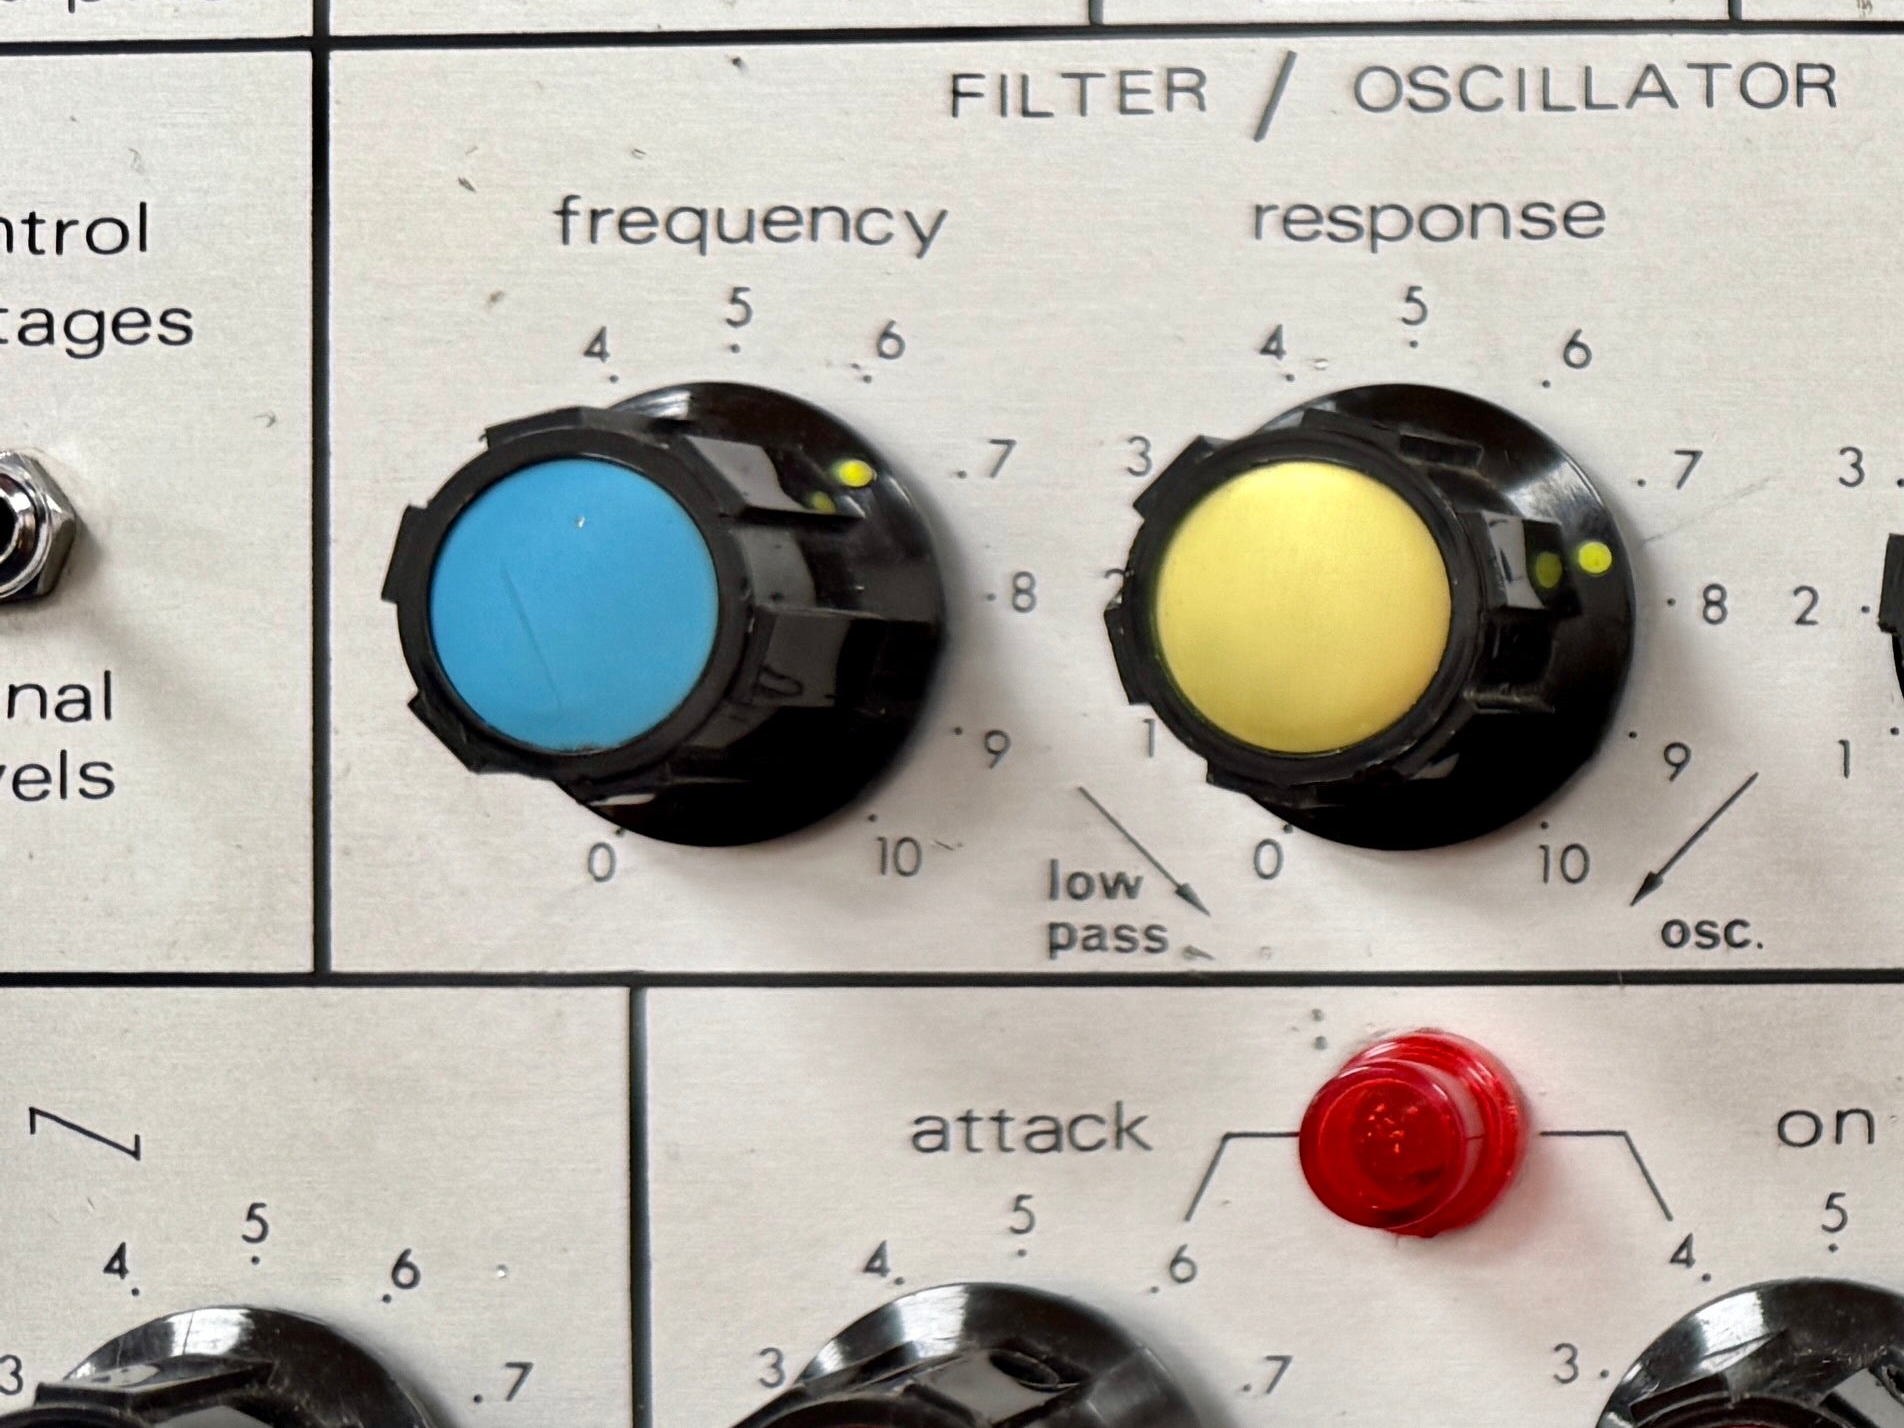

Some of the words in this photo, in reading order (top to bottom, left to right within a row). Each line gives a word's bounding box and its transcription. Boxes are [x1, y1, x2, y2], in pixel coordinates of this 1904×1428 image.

[946, 66, 1207, 119] FILTER
[1348, 60, 1837, 114] OSCILLATOR
[551, 194, 948, 259] frequency
[1250, 200, 1606, 254] response
[723, 286, 753, 329] 5
[1254, 324, 1287, 361] 4
[1673, 448, 1704, 490] 7
[1011, 571, 1036, 613] 8
[1791, 585, 1819, 626] 2
[0, 749, 115, 802] els
[1663, 742, 1691, 782] 9
[876, 836, 922, 877] 10
[1047, 859, 1144, 901] low
[1046, 922, 1169, 960] pass
[1659, 918, 1763, 953] osc.
[907, 1100, 1153, 1155] attack
[1775, 1108, 1875, 1149] on
[241, 1202, 269, 1244] 5
[1005, 1194, 1036, 1235] 5
[502, 1361, 534, 1402] 7
[1551, 1342, 1579, 1385] 3
